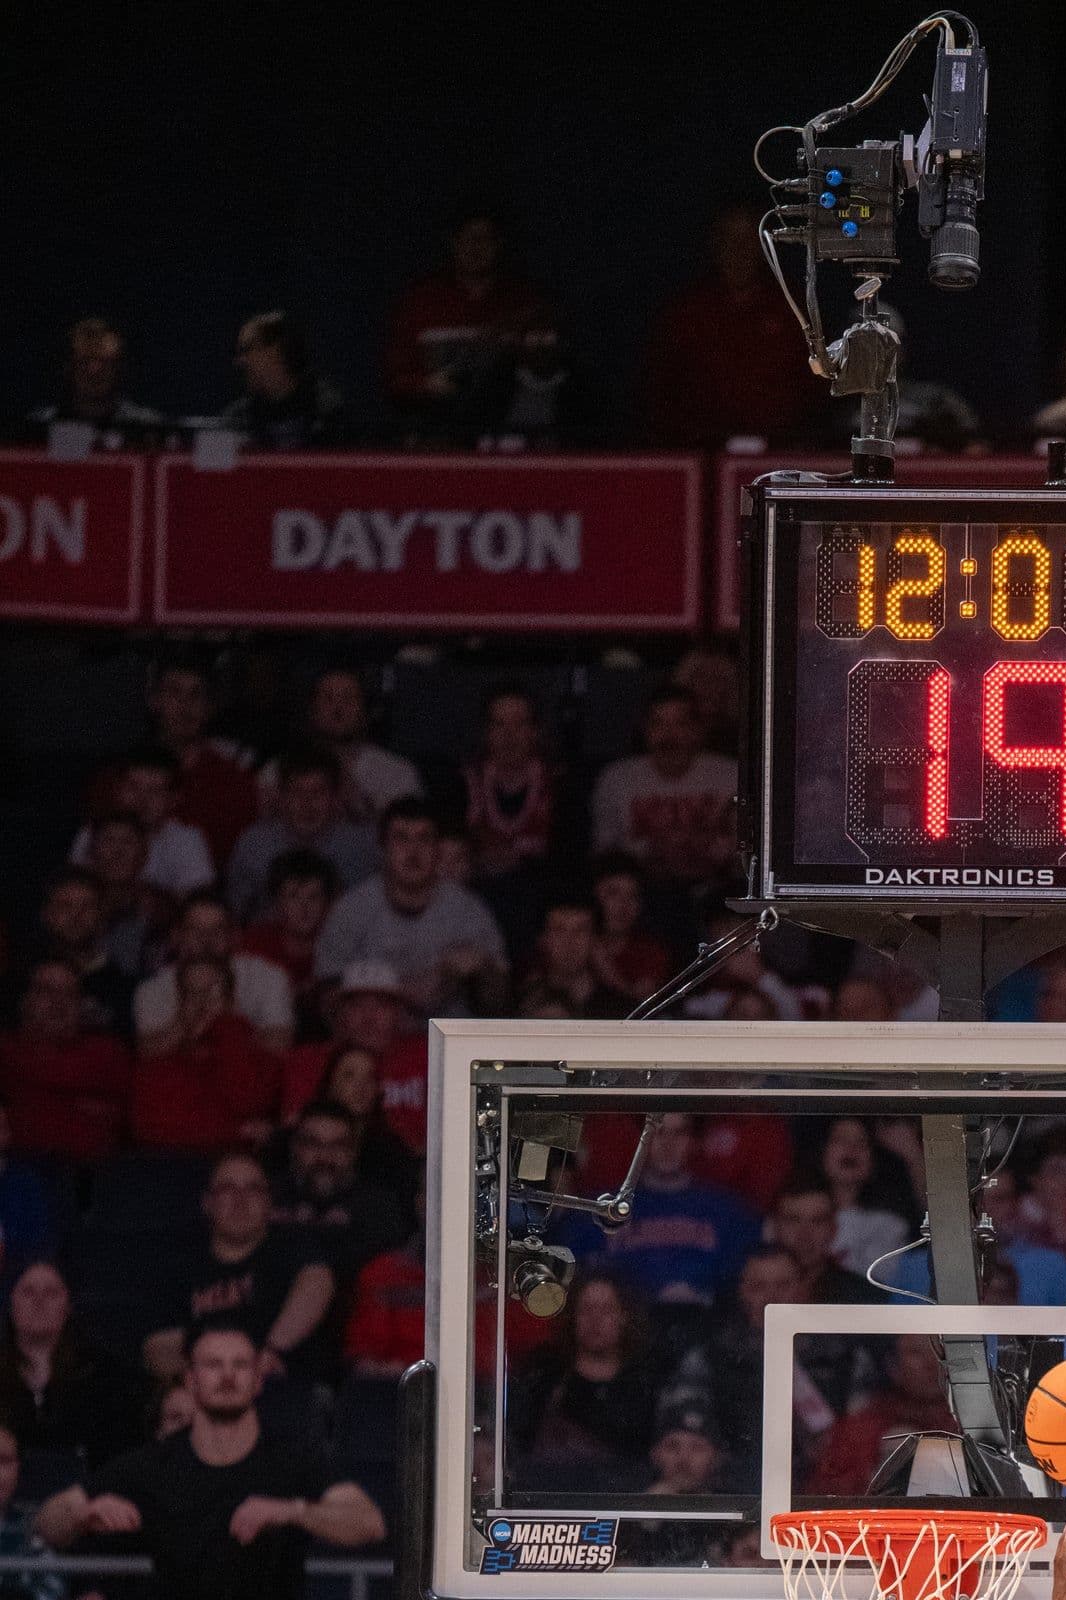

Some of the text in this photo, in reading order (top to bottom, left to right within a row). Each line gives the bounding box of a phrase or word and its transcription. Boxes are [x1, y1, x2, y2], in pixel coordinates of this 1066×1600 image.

[272, 508, 581, 570] DAYTON
[865, 868, 1055, 886] DAKTRONICS
[511, 1524, 581, 1544] MARCH
[519, 1545, 613, 1566] MADNESS
